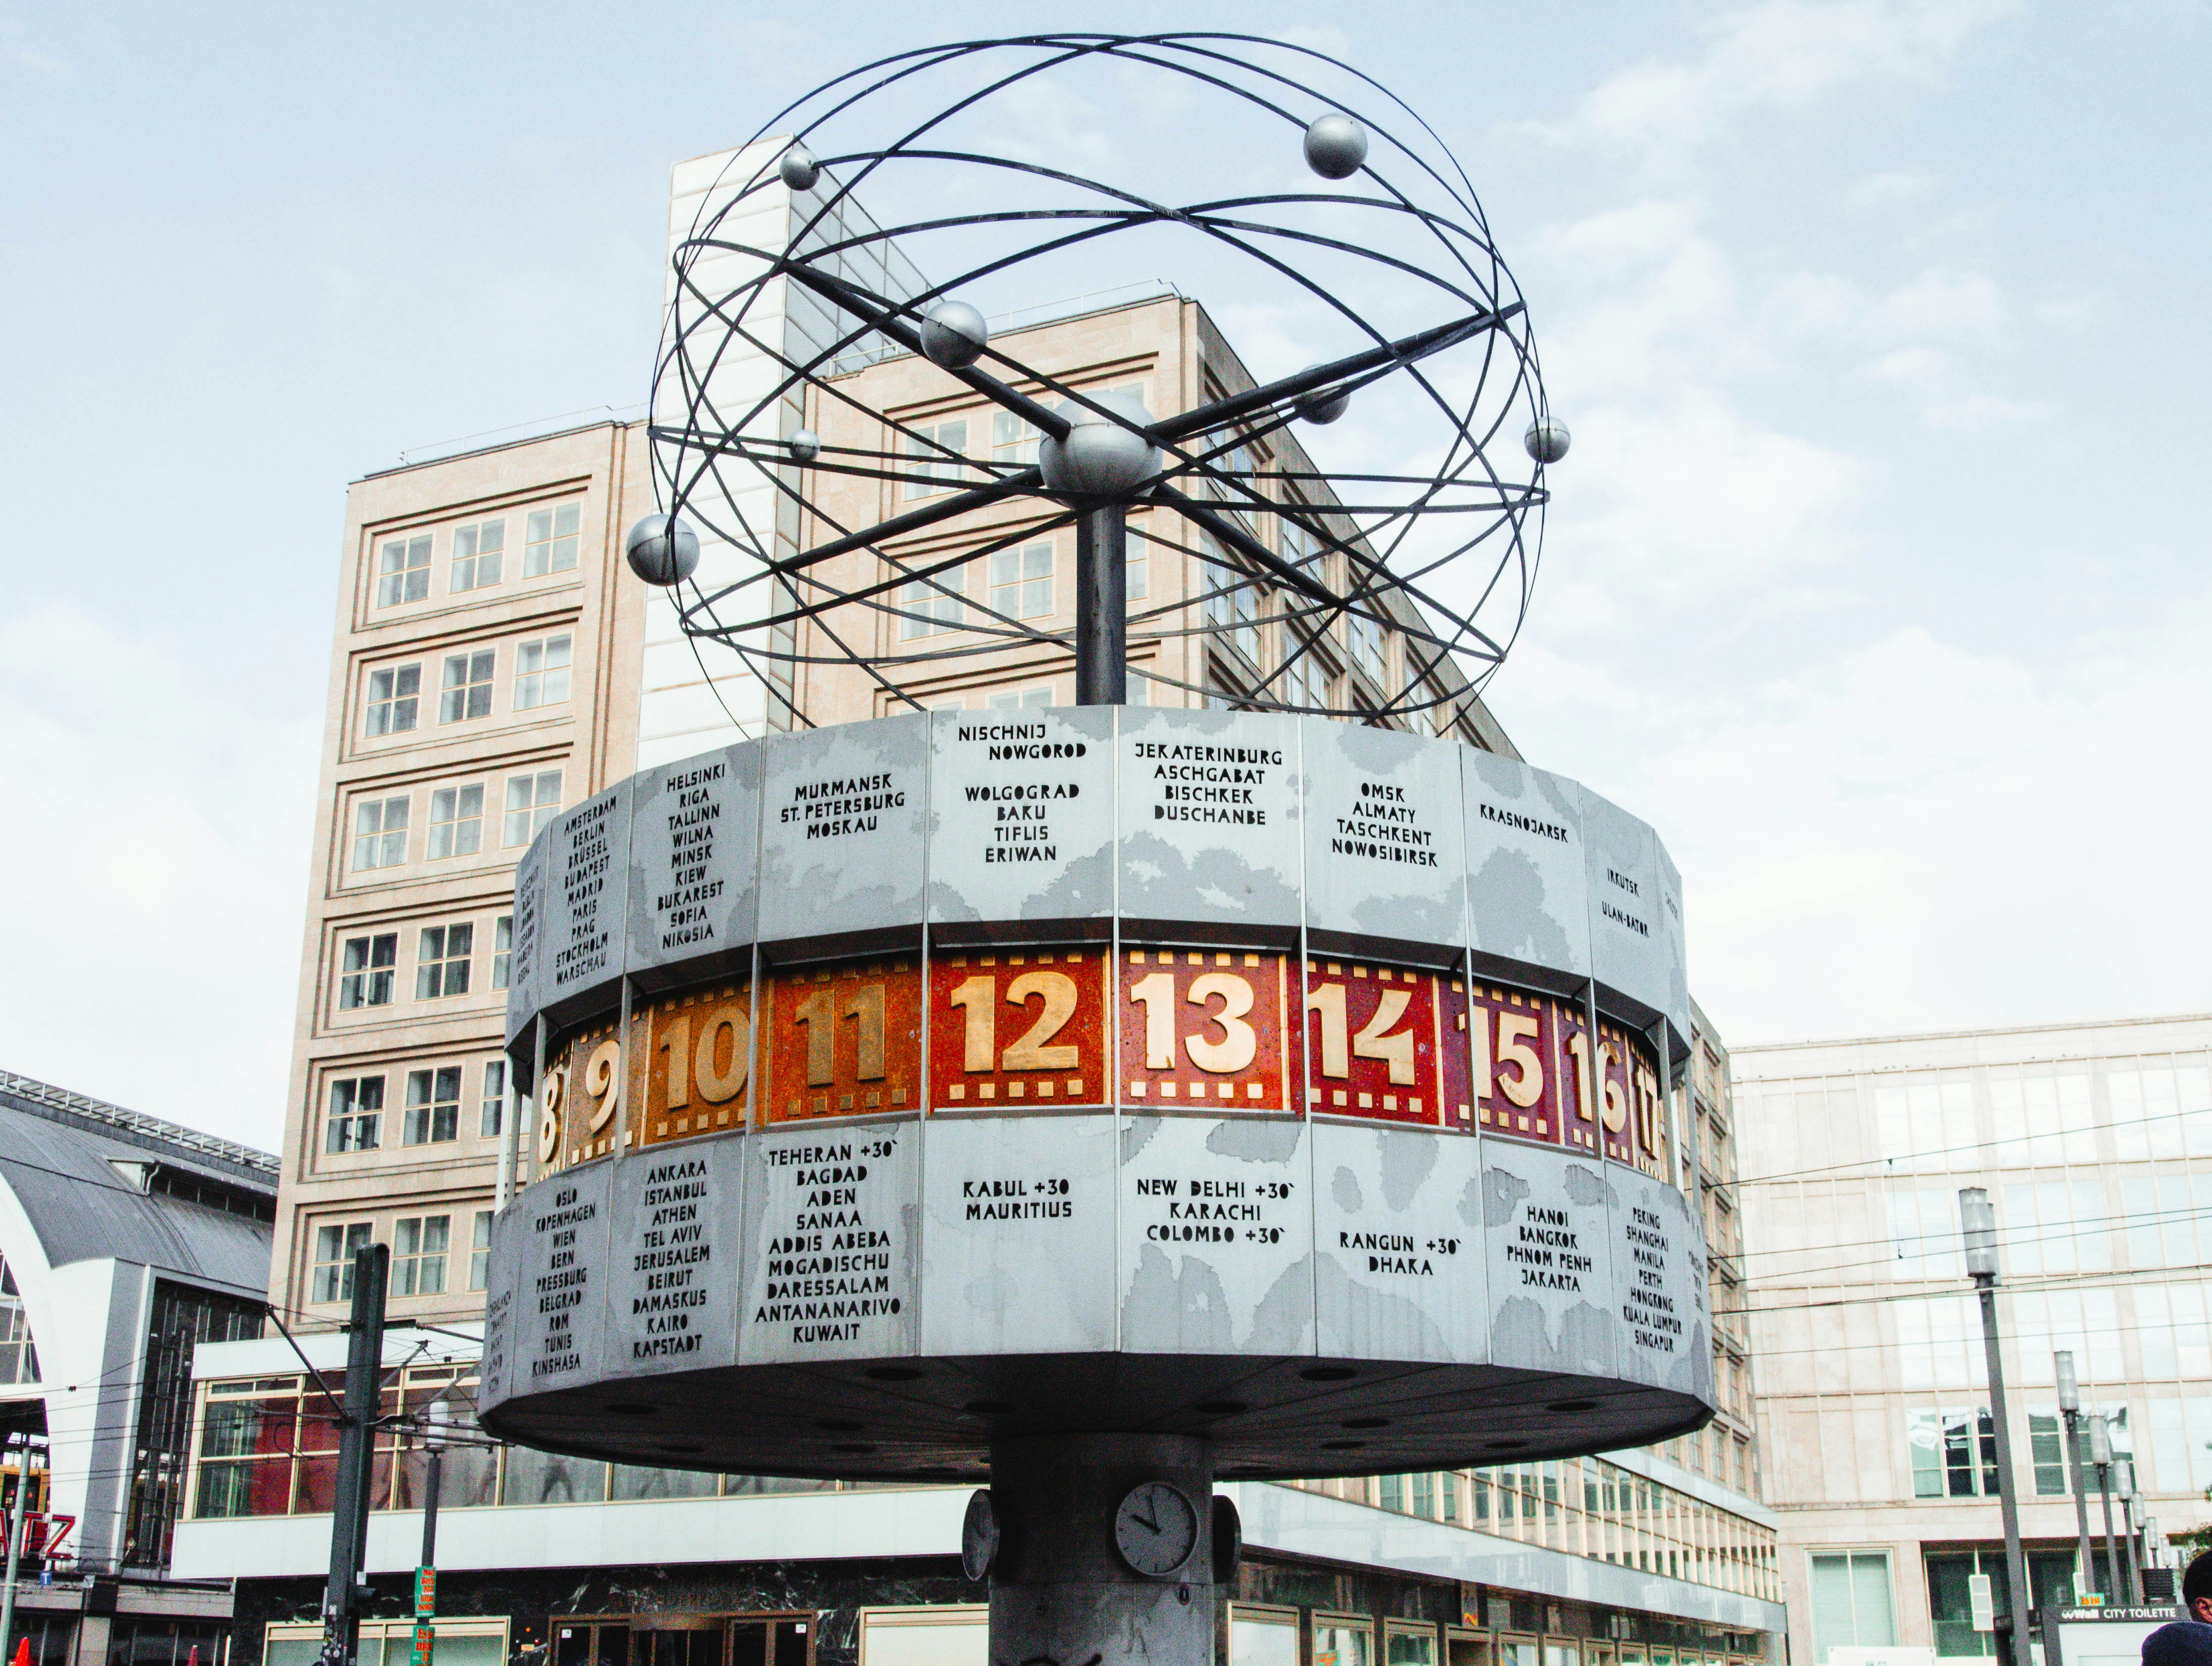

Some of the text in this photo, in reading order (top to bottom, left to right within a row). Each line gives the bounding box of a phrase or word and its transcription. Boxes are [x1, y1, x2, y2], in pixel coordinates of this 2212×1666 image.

[959, 724, 1046, 742] NISCHNIJ
[989, 743, 1086, 760] NOWGOROD
[1136, 743, 1282, 765] JEKATERINBURG
[667, 763, 725, 792] HELSINKI
[1154, 765, 1265, 784] ASCHGABAT
[680, 788, 709, 808] RIGA
[795, 773, 892, 801] MURMANSK
[965, 784, 1079, 802] WOLGOGRAD
[1165, 785, 1253, 804] BISCHKEK
[1361, 782, 1405, 802] OMSK
[564, 796, 617, 836] AMSTERDAM
[668, 803, 720, 830] TALLINN
[781, 792, 905, 823] ST. PETERSBURG
[997, 805, 1046, 821] BAKU
[1154, 806, 1265, 825] DUSCHANBE
[1352, 802, 1416, 823] ALMATY
[573, 821, 604, 848] BERLIN
[807, 816, 877, 839] MOSKAU
[994, 826, 1048, 842] TIFLIS
[1337, 819, 1432, 846] TASCHKENT
[1480, 804, 1568, 843] KRASNOJARSK
[672, 825, 713, 848] WILNA
[568, 841, 607, 869] BRÜSSEL
[671, 845, 712, 868] MINSK
[985, 845, 1056, 862] ERIWAN
[1332, 838, 1438, 867] NOWOSIBIRSK
[565, 855, 609, 889] BUDAPEST
[675, 865, 707, 886] KIEW
[1607, 868, 1640, 897] IRKUTSK
[568, 877, 603, 906] MADRID
[658, 881, 724, 911] BUKAREST
[572, 899, 597, 922] PARIS
[670, 905, 707, 928] SOFIA
[1602, 901, 1649, 938] ULAN-BATOR
[571, 918, 595, 942] PRAG
[662, 924, 714, 949] NIKOSIA
[556, 932, 608, 967] STOCKHOLM
[556, 952, 606, 986] WARSCHAU
[951, 971, 1078, 1072] 12
[1130, 973, 1257, 1073] 13
[796, 983, 885, 1086] 11
[1308, 983, 1415, 1085] 14
[660, 1006, 751, 1110] 10
[1458, 1005, 1544, 1107] 15
[585, 1040, 620, 1136] 9
[1569, 1031, 1627, 1134] 16
[539, 1072, 563, 1164] 8
[1635, 1065, 1659, 1160] 17
[769, 1144, 852, 1166] TEHERAN
[647, 1160, 707, 1185] ANKARA
[797, 1165, 867, 1186] BAGDAD
[556, 1188, 577, 1208] OSLO
[645, 1181, 707, 1207] ISTANBUL
[806, 1188, 856, 1208] ADEN
[963, 1180, 1027, 1198] KABUL
[1138, 1179, 1178, 1196] NEW
[1191, 1180, 1245, 1198] DELHI
[536, 1203, 596, 1233] KOPENHAGEN
[652, 1204, 696, 1226] ATHEN
[796, 1210, 862, 1230] SANAA
[966, 1201, 1072, 1221] MAURITIUS
[1169, 1202, 1261, 1221] KARACHI
[1527, 1206, 1568, 1227] HANOI
[1632, 1207, 1660, 1230] PEKING
[553, 1230, 576, 1248] WIEN
[644, 1224, 702, 1248] TEL AVIV
[769, 1231, 891, 1255] ADDIS ABEBA
[1147, 1224, 1234, 1243] COLOMBO
[1339, 1231, 1414, 1253] RANGUN
[1519, 1226, 1578, 1250] BANGKOK
[1626, 1225, 1668, 1252] SHANGHAI
[551, 1250, 574, 1269] BERN
[634, 1245, 710, 1272] JERUSALEM
[768, 1253, 889, 1277] MOGADISCHU
[1369, 1256, 1434, 1276] DHAKA
[1507, 1246, 1592, 1273] PHNOM PENH
[1634, 1247, 1665, 1271] MANILA
[536, 1267, 586, 1293] PRESSBURG
[648, 1269, 693, 1291] BEIRUT
[768, 1276, 889, 1300] DARESSALAM
[1521, 1270, 1581, 1292] JAKARTA
[1639, 1269, 1662, 1290] PERTH
[539, 1290, 581, 1314] BELGRAD
[633, 1289, 707, 1315] DAMASKUS
[754, 1298, 900, 1323] ANTANANARIVO
[1631, 1287, 1674, 1313] HONGKONG
[549, 1314, 569, 1332] ROM
[647, 1314, 688, 1335] KAIRO
[1623, 1305, 1683, 1336] KUALA LUMPUR
[545, 1334, 572, 1354] TUNIS
[793, 1323, 860, 1343] KUWAIT
[1635, 1329, 1675, 1354] SINGAPUR
[634, 1334, 702, 1359] KAPSTADT
[532, 1353, 580, 1377] KINSHASA
[2103, 1608, 2127, 1618] CITY
[2128, 1607, 2176, 1618] TOILETTE
